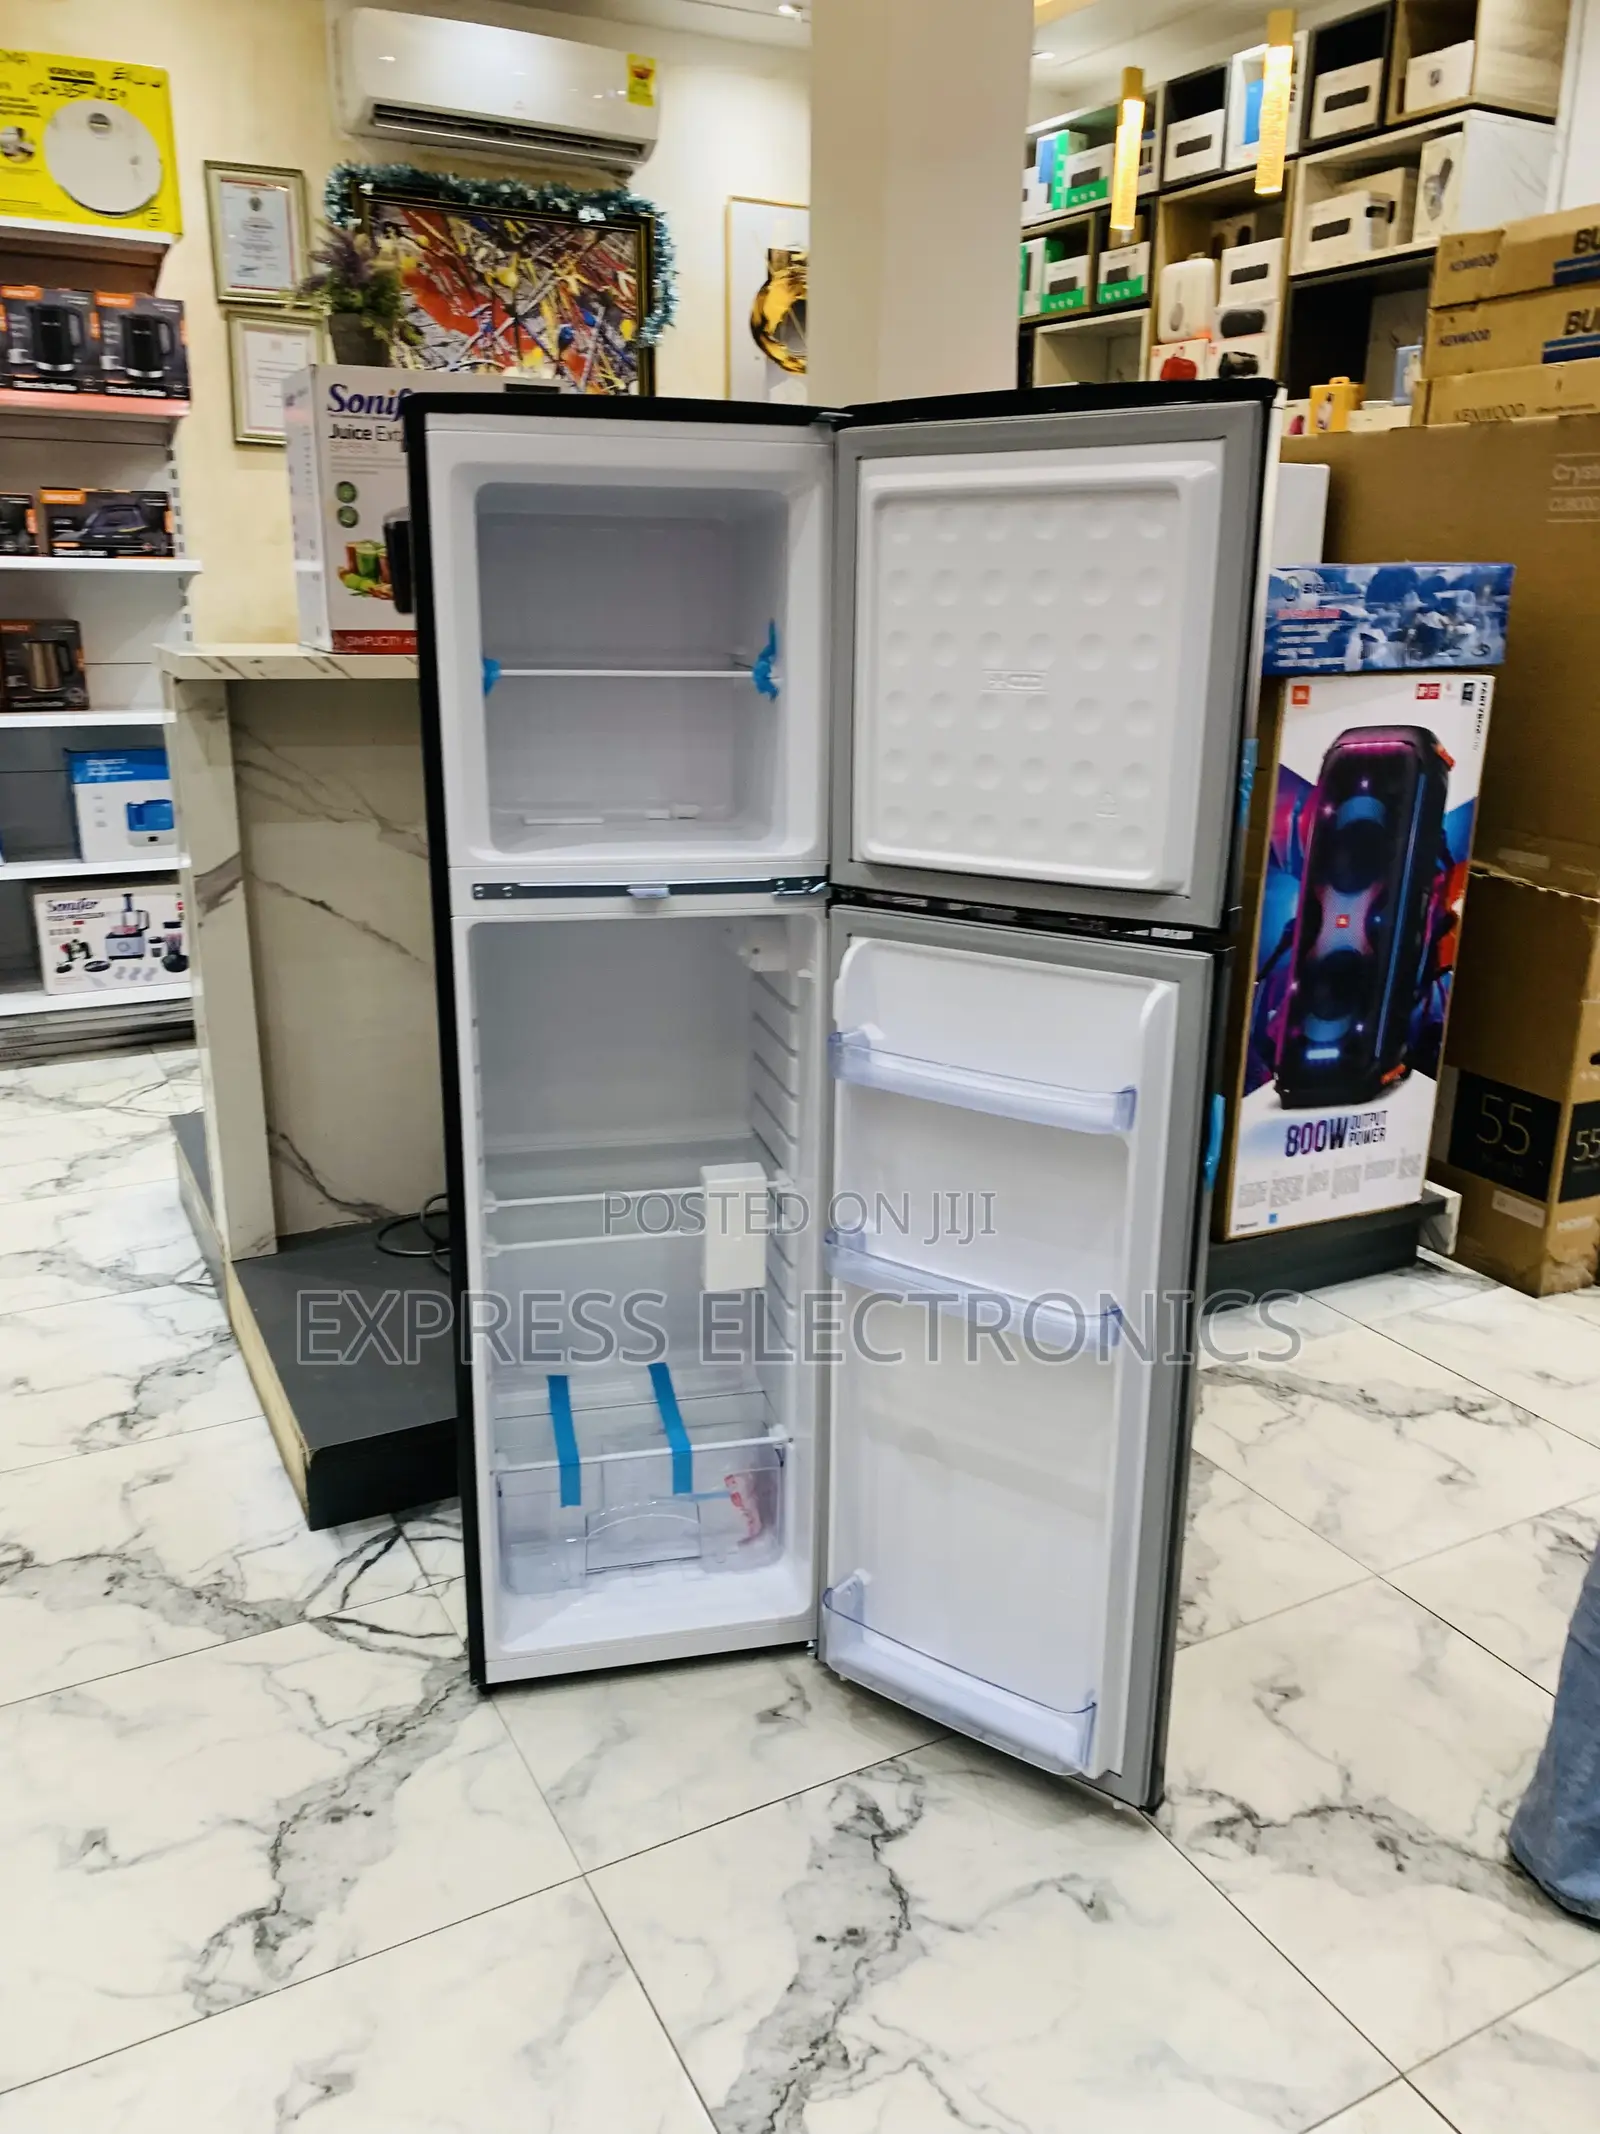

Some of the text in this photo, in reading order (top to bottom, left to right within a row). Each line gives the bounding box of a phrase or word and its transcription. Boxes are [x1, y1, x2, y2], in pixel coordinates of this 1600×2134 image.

[328, 424, 372, 441] Juice
[1285, 1110, 1388, 1157] 800W OUTPUT
[1349, 1127, 1386, 1146] POWER
[1476, 1093, 1532, 1155] 55
